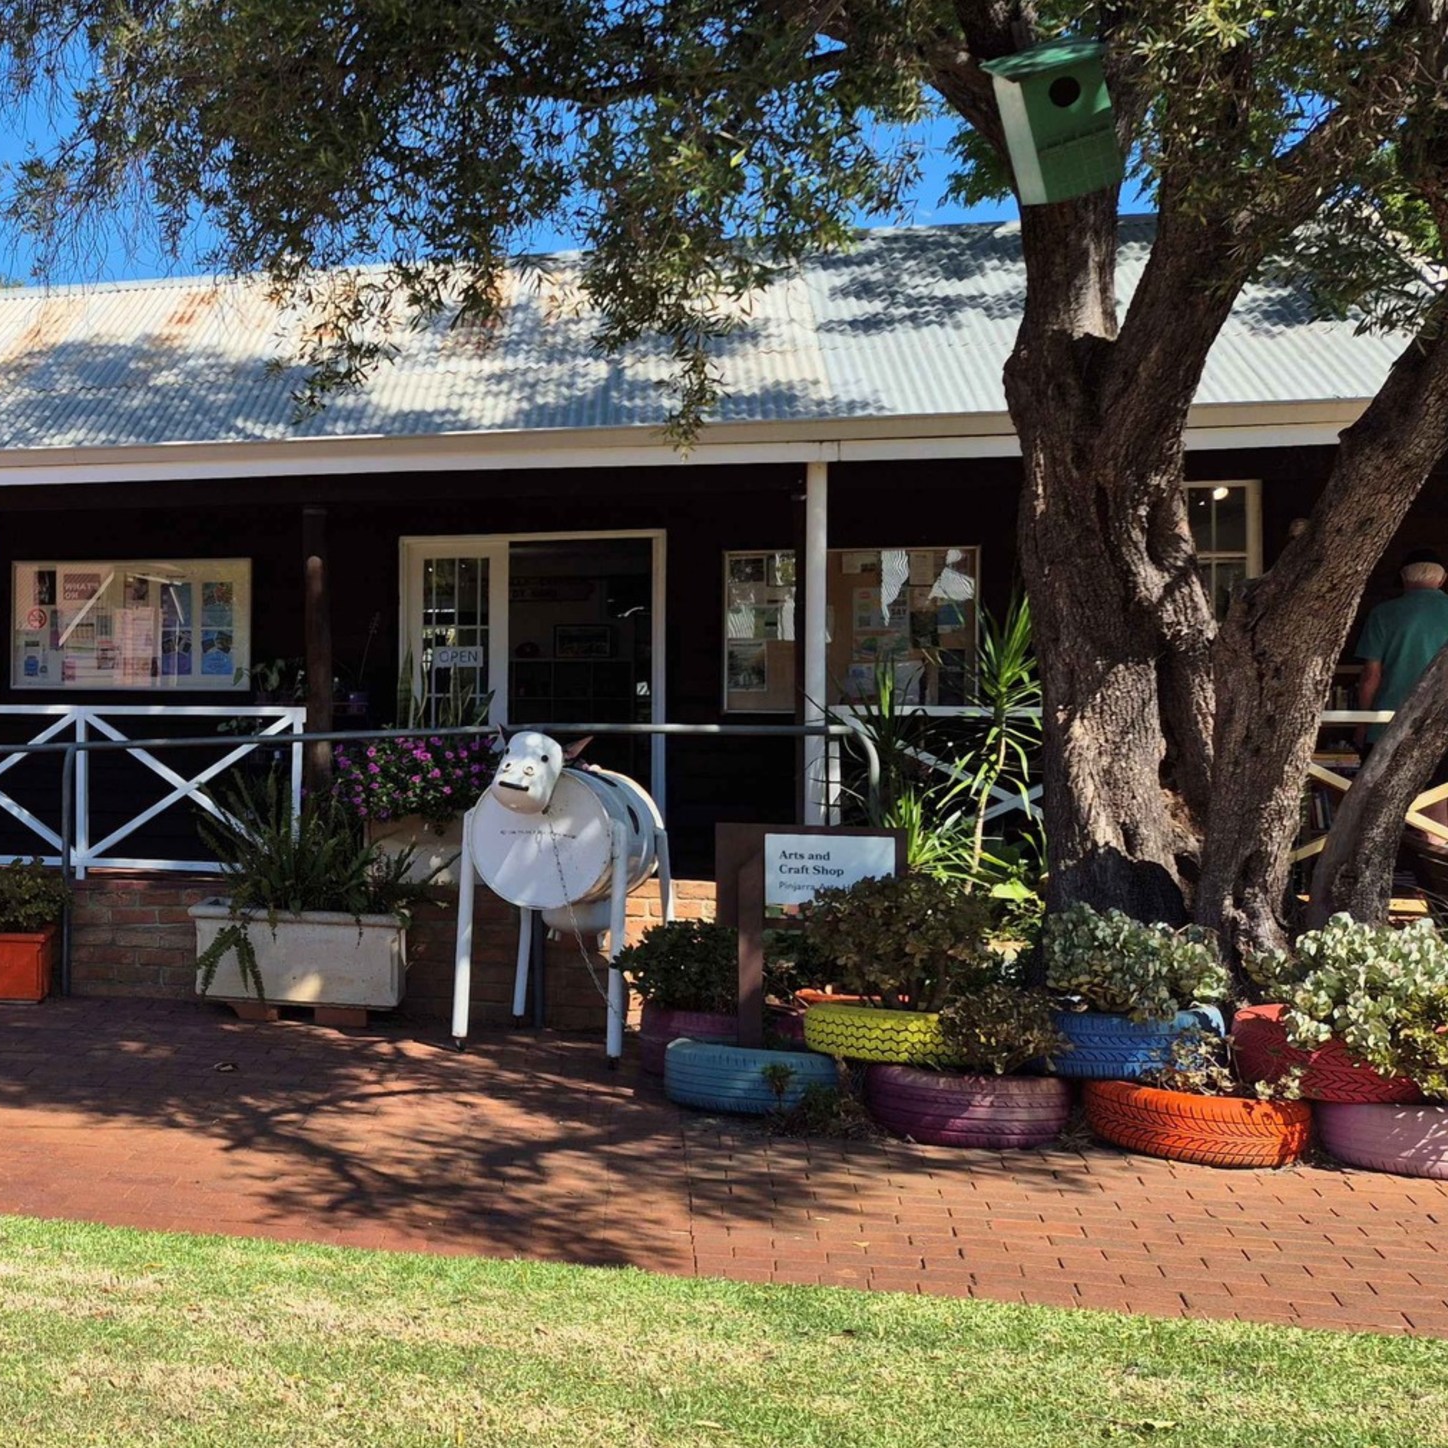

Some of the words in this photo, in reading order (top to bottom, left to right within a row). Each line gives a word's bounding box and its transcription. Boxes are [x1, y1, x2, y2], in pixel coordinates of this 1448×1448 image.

[439, 650, 478, 663] OPEN
[779, 850, 805, 860] Arts
[808, 851, 831, 861] and
[778, 863, 810, 875] Craft
[812, 865, 845, 878] Shop
[778, 881, 815, 892] Pinjarra
